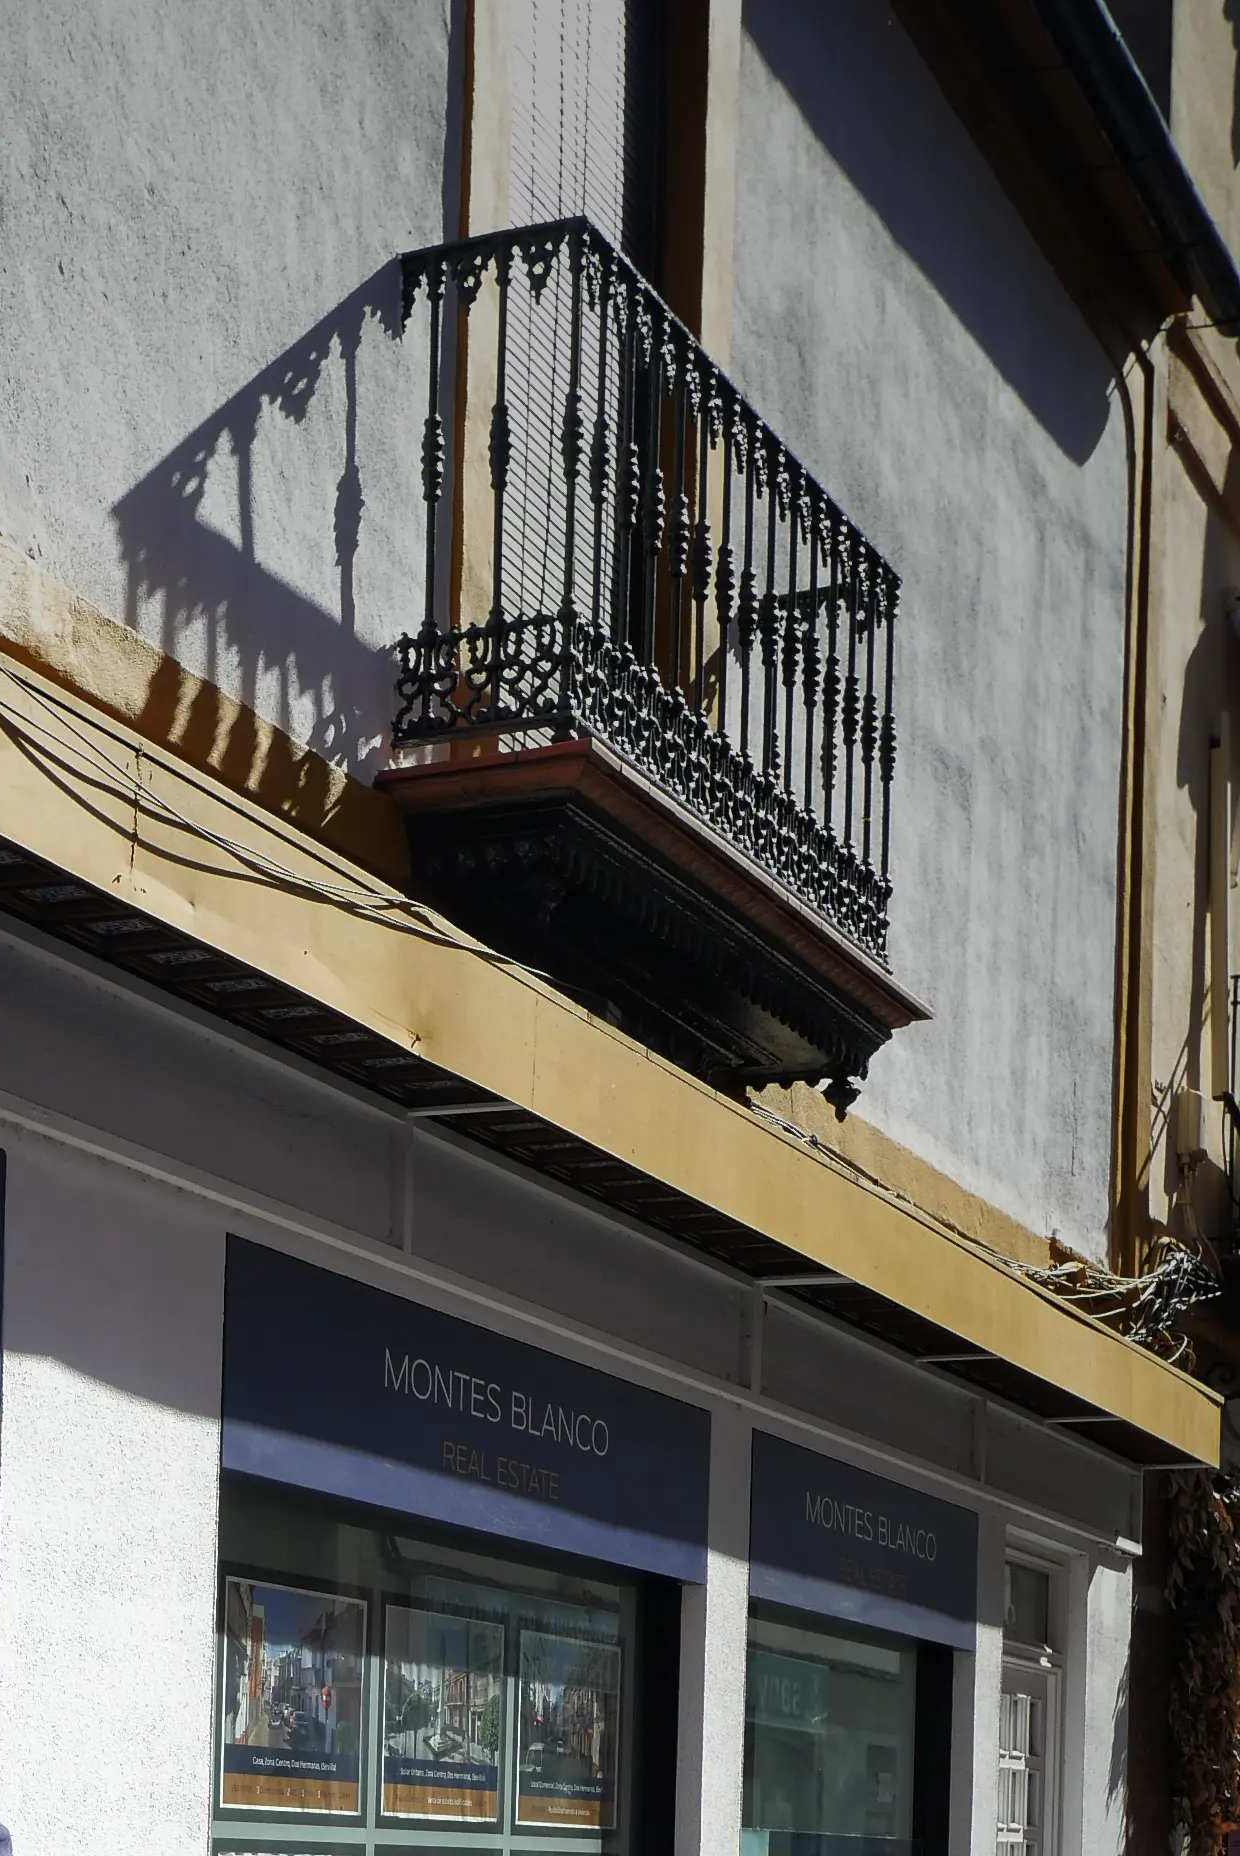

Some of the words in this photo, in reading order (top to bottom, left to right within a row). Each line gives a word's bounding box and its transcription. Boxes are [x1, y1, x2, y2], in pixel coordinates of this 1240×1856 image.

[384, 1347, 501, 1423] MONTES
[511, 1391, 609, 1456] BLANCO
[443, 1441, 491, 1481] REAL
[497, 1456, 560, 1500] ESTATE
[806, 1491, 873, 1541] MONTES
[878, 1516, 937, 1561] BLANCO
